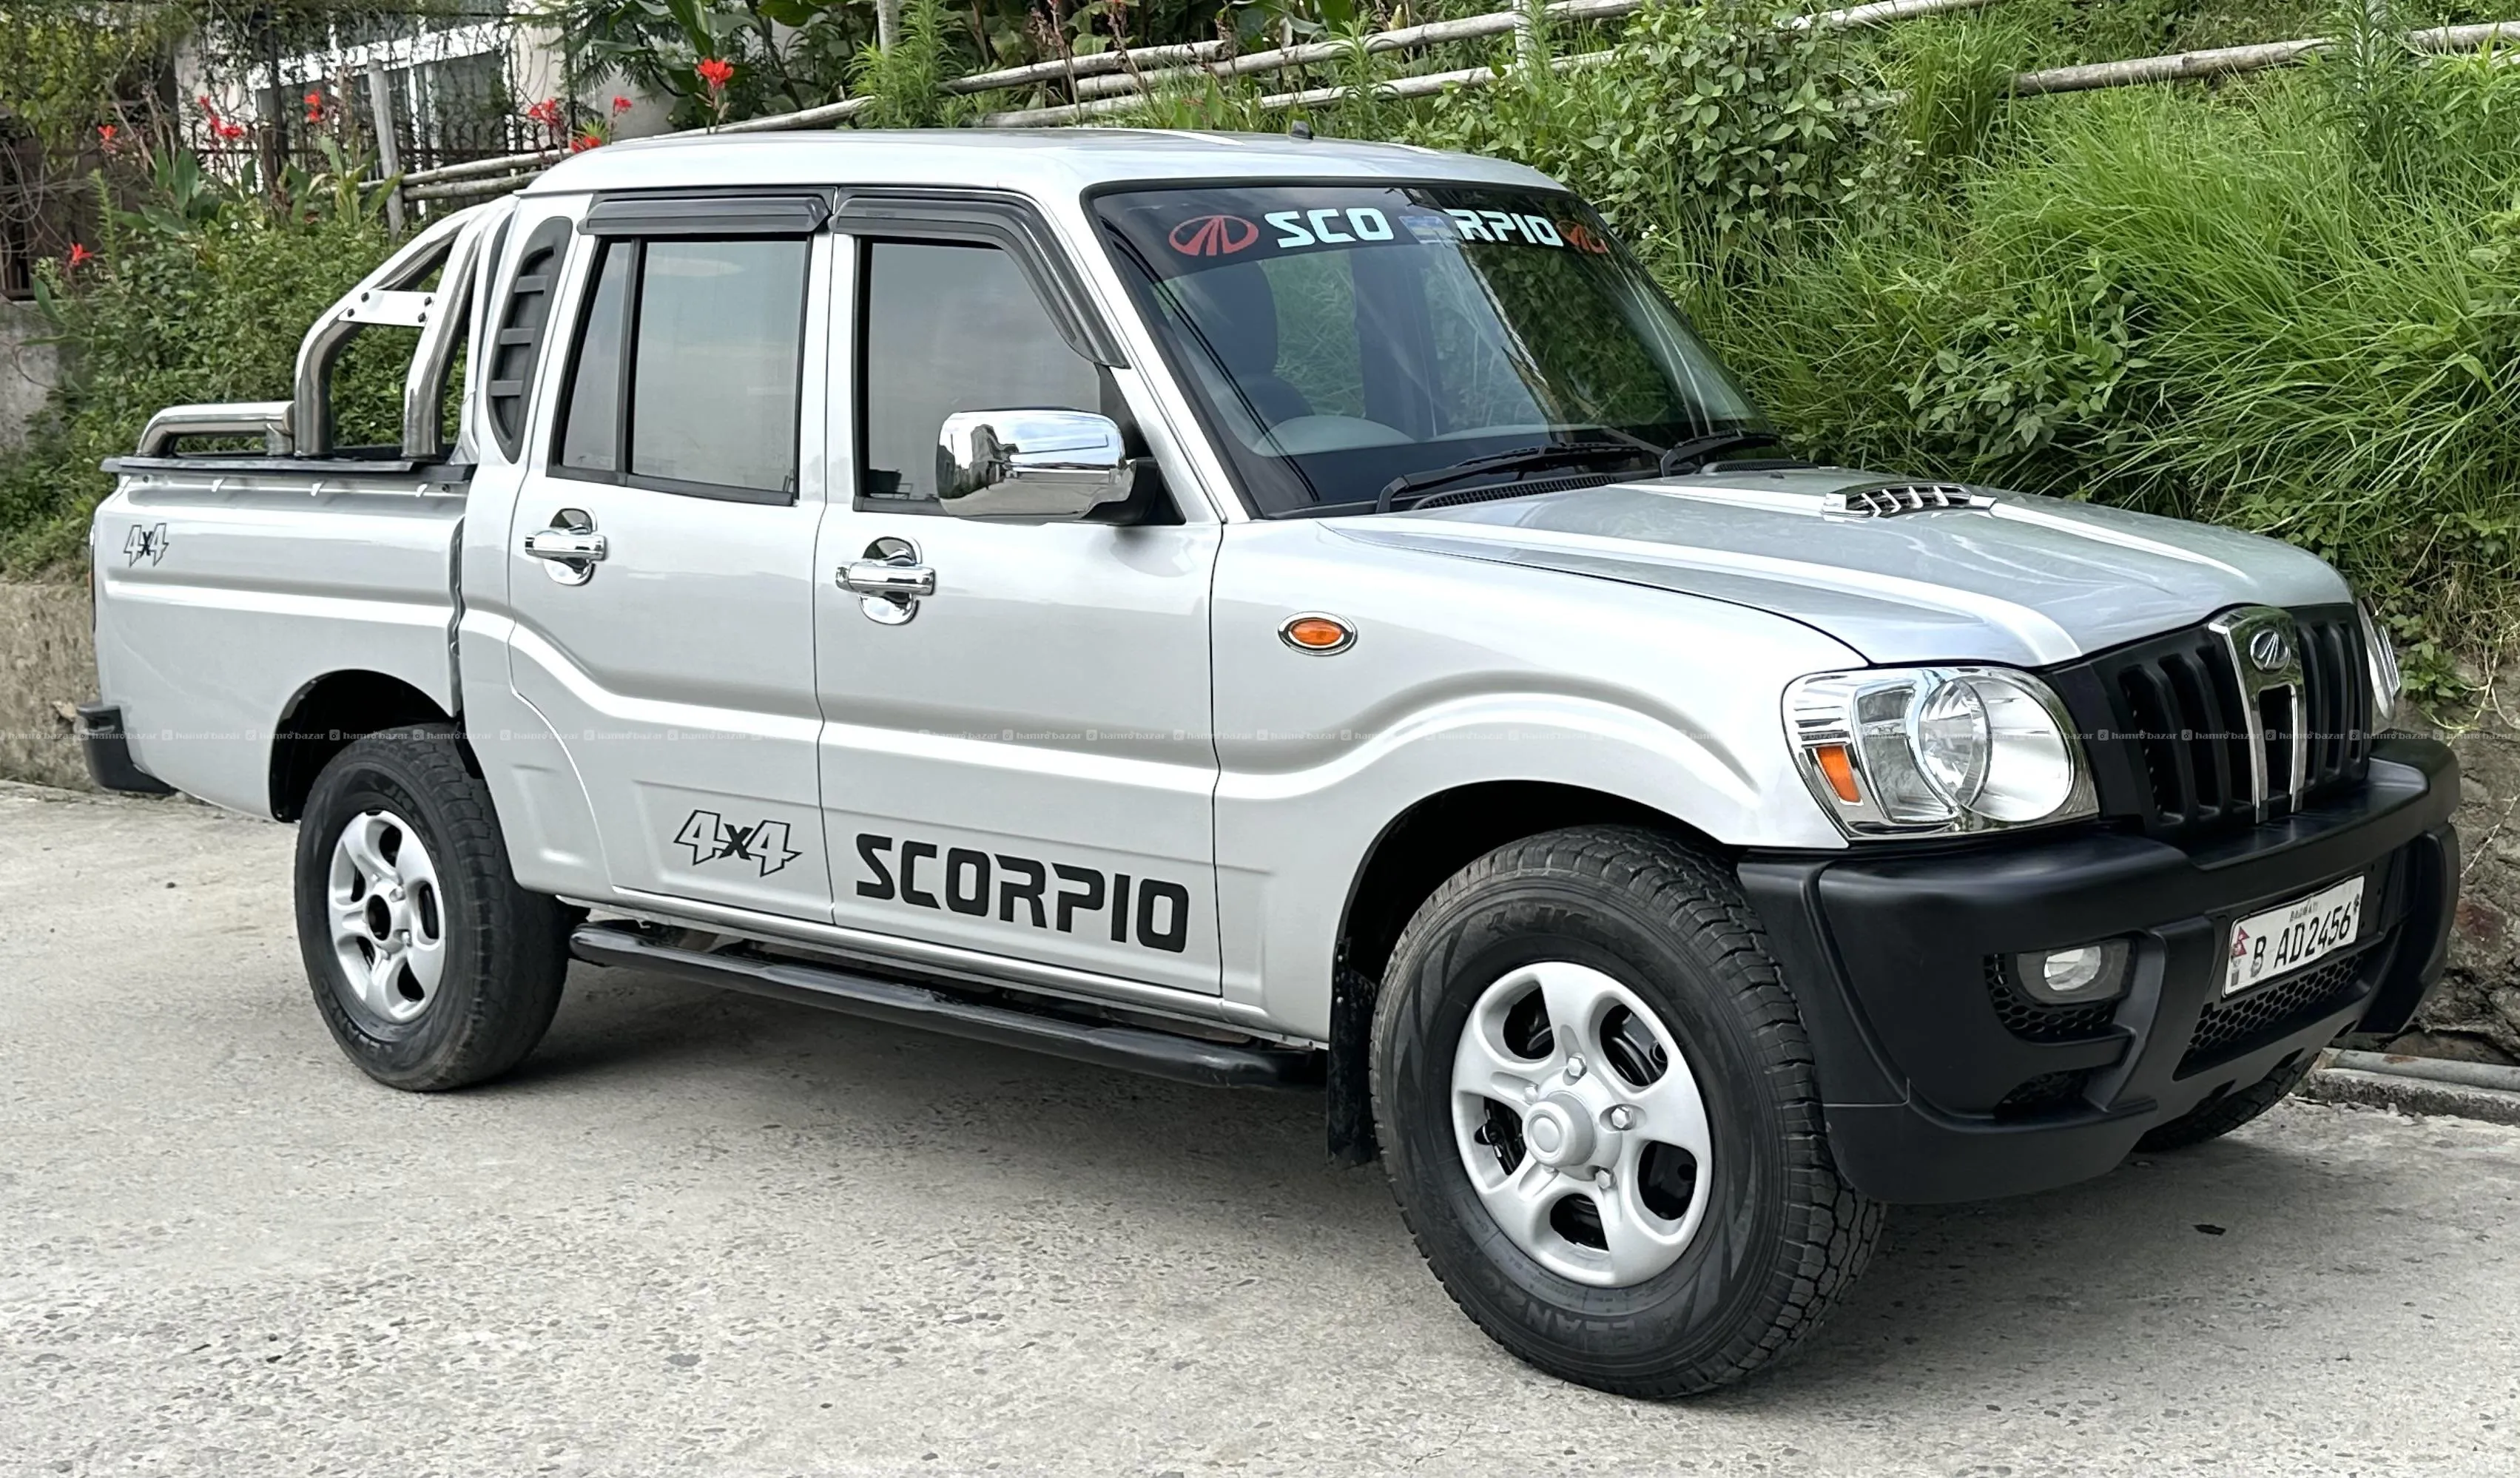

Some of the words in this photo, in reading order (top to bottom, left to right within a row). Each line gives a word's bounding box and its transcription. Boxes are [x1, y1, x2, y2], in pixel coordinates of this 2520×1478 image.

[1264, 207, 1394, 248] SCO
[855, 833, 1190, 954] SCORPIO
[2250, 935, 2267, 978] B
[2274, 902, 2352, 969] AD2456
